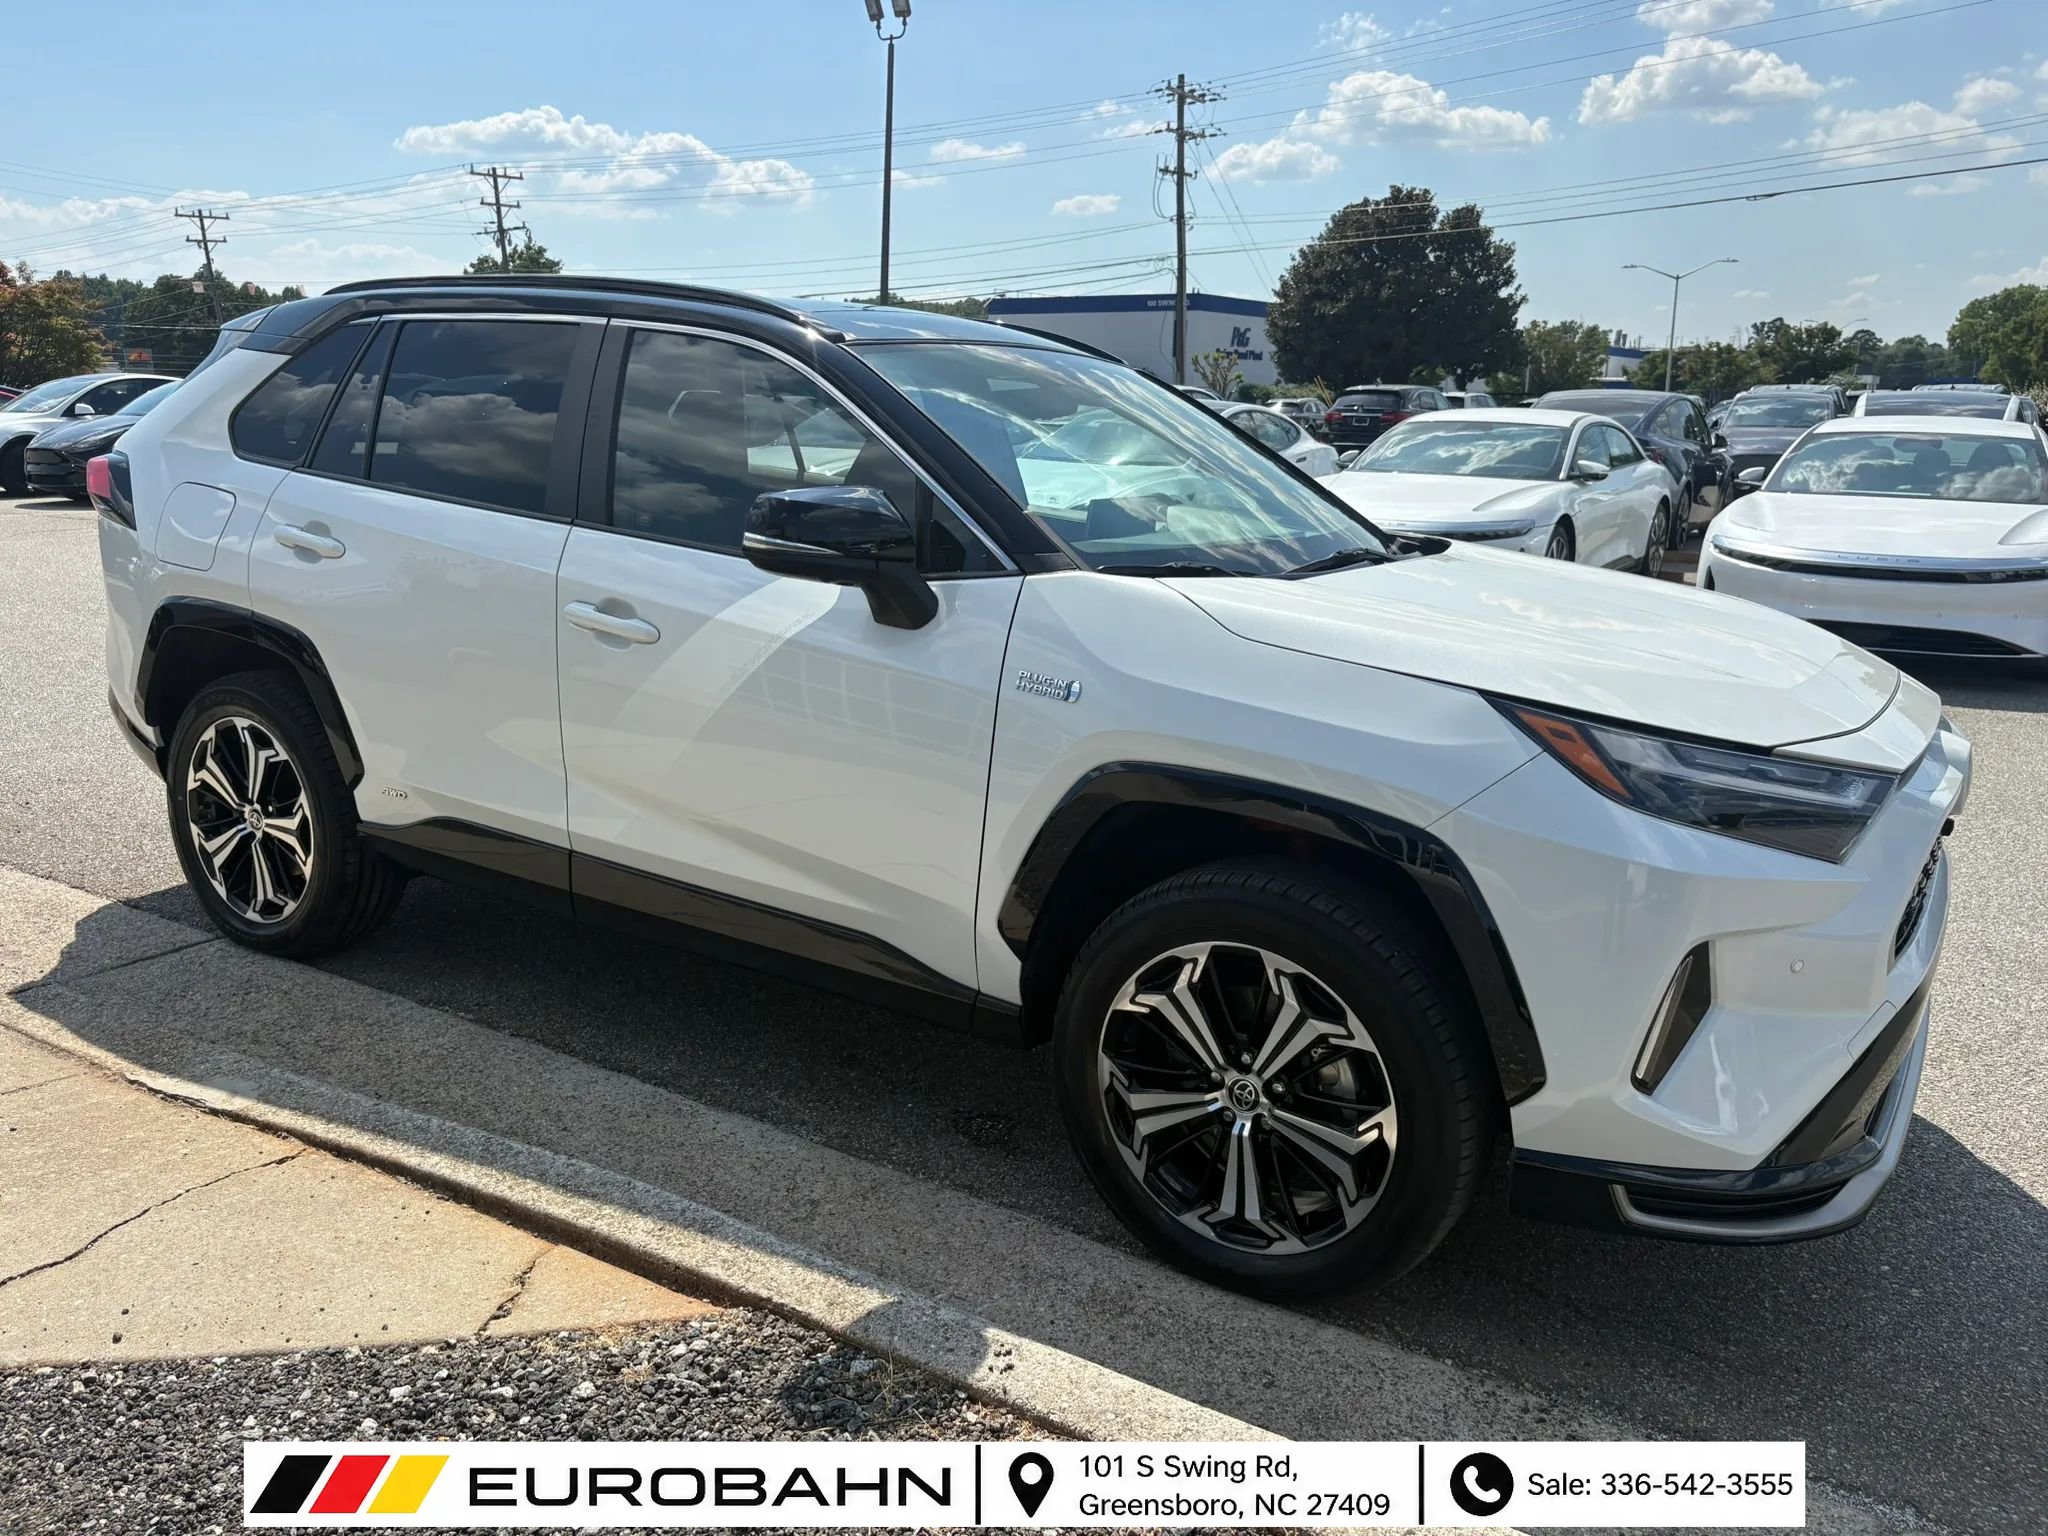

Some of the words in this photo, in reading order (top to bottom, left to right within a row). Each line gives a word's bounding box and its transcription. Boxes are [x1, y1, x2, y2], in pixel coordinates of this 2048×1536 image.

[1231, 326, 1251, 347] P&G
[1016, 679, 1064, 700] HYBRID
[1018, 670, 1068, 690] PLUG-IN
[382, 787, 408, 799] AWD
